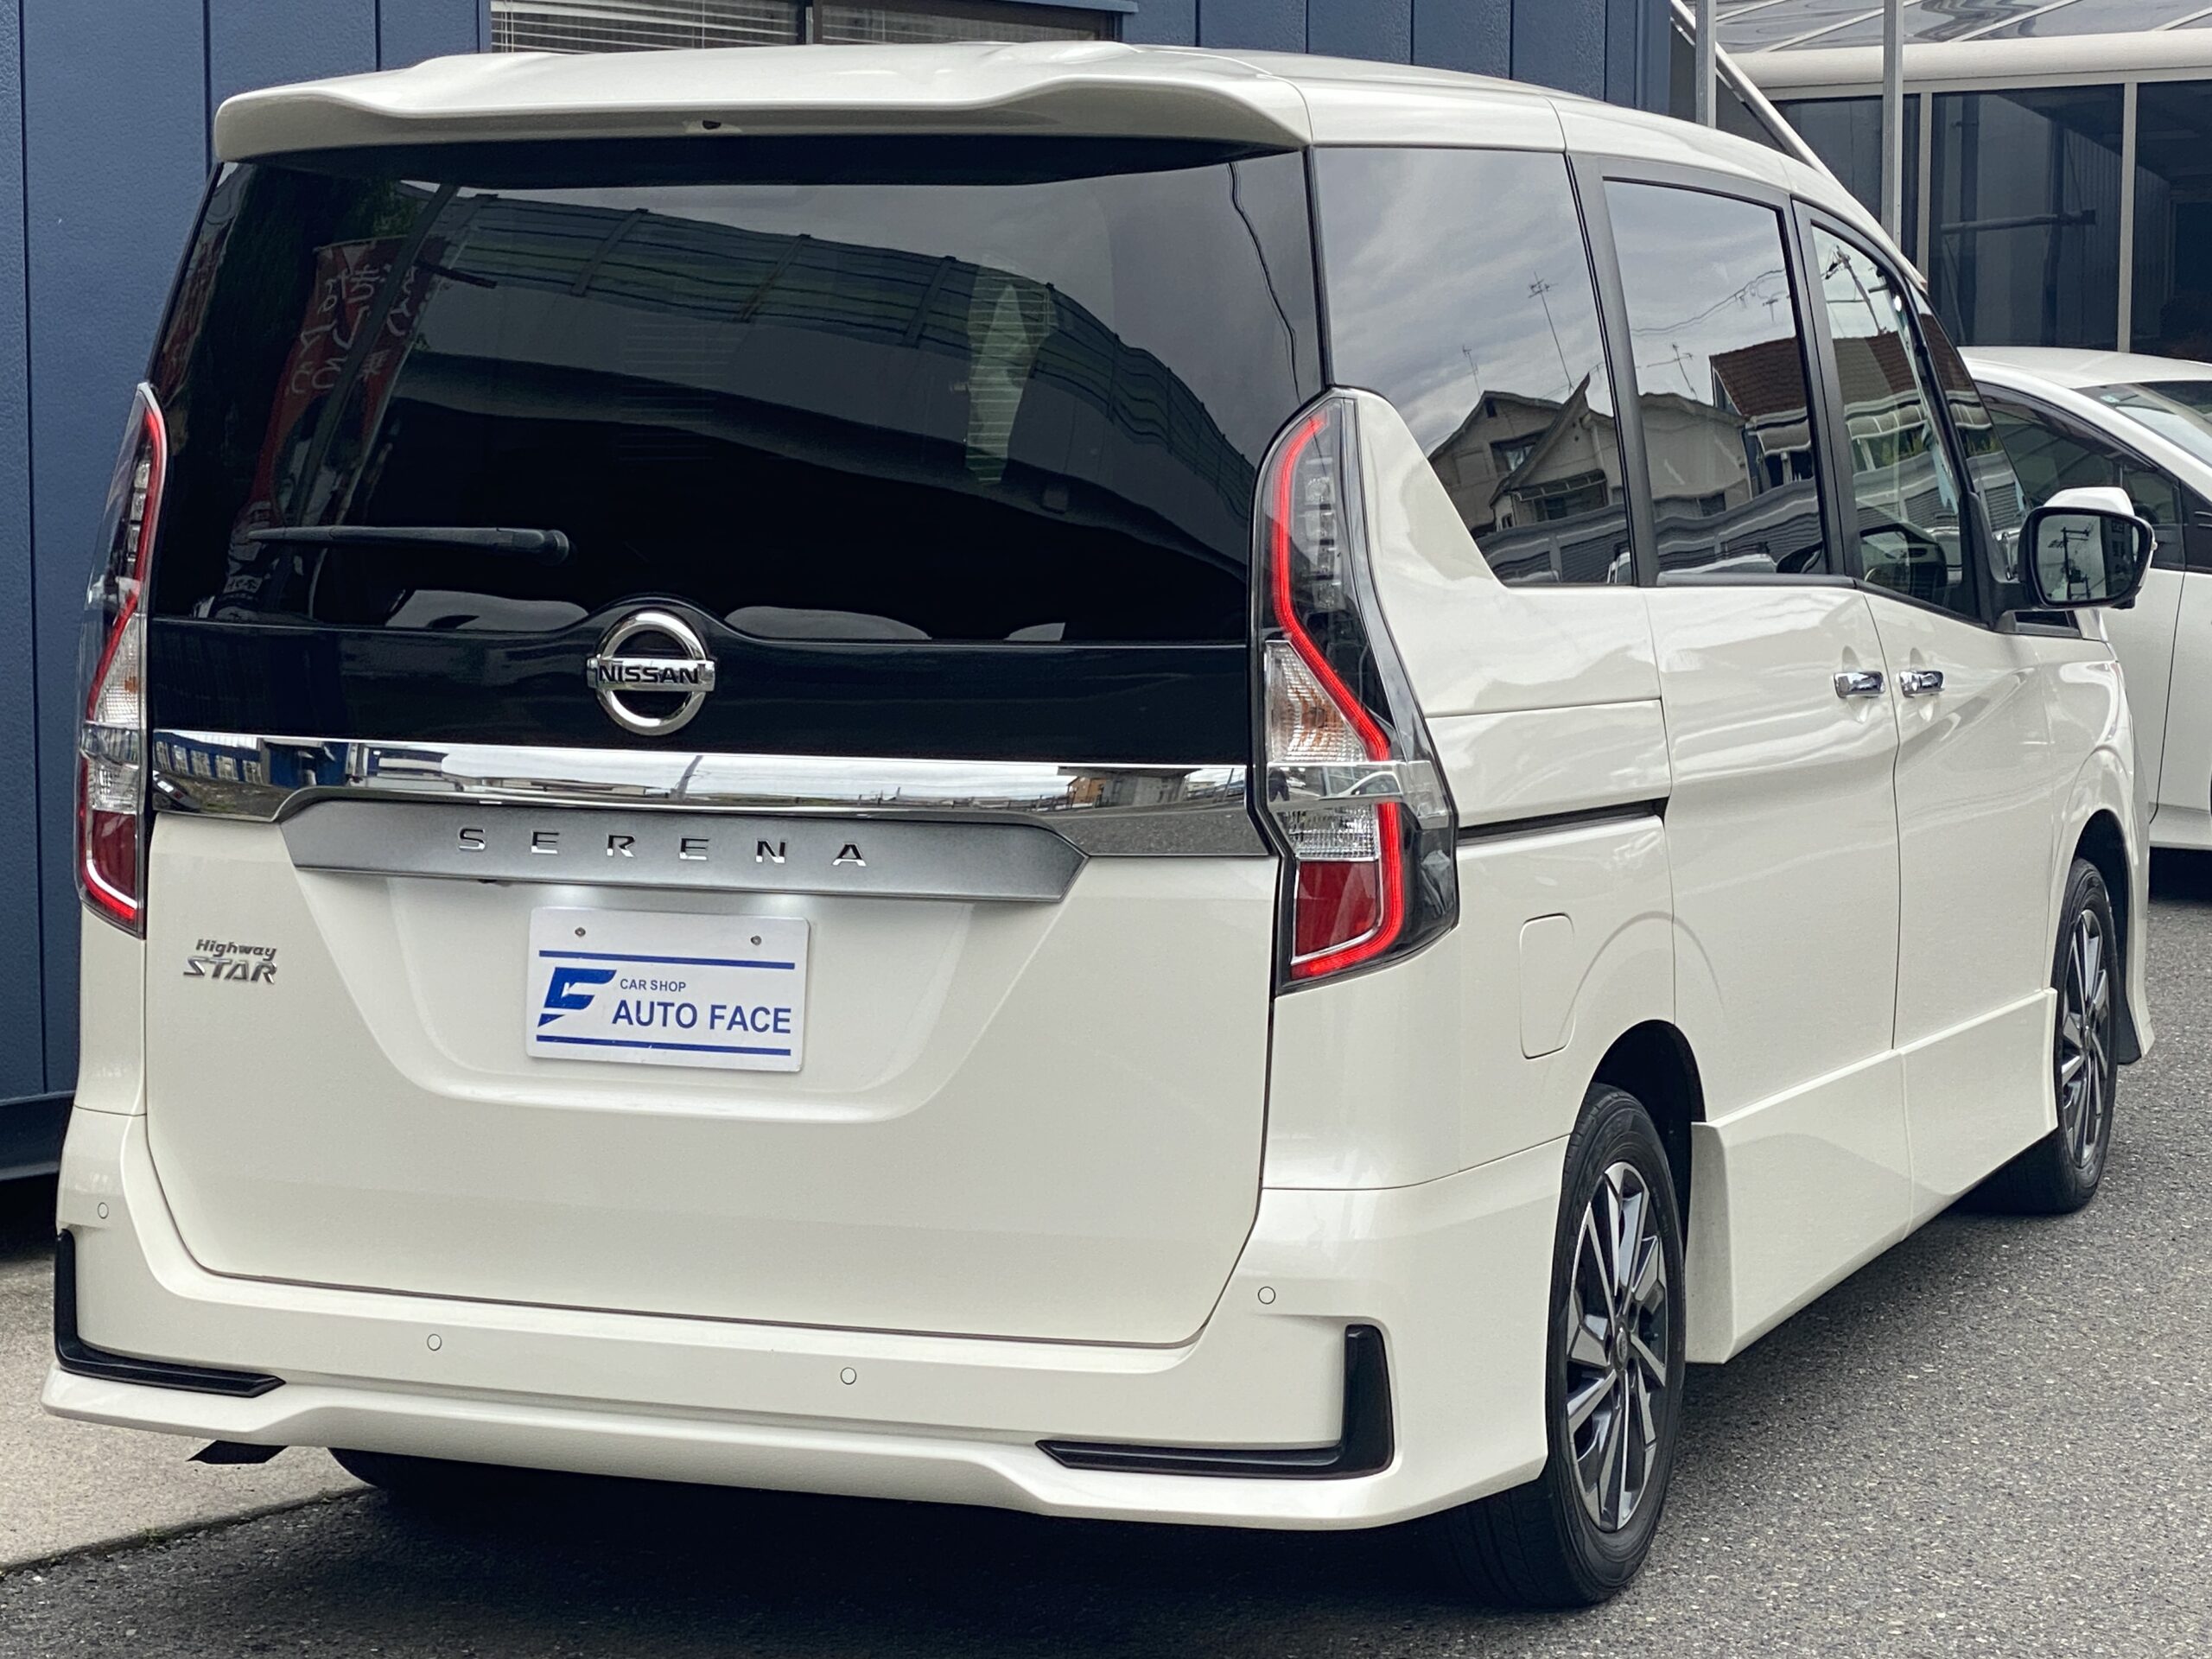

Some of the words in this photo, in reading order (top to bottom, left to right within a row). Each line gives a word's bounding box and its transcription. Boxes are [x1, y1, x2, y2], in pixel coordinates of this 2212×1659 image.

[598, 664, 699, 684] NISSAN
[457, 828, 868, 868] SERENA
[195, 938, 277, 962] Highway
[182, 955, 278, 985] STAR
[620, 978, 647, 991] CAR
[650, 980, 687, 993] SHOP
[612, 999, 698, 1029] AUTO
[709, 1003, 791, 1034] FACE
